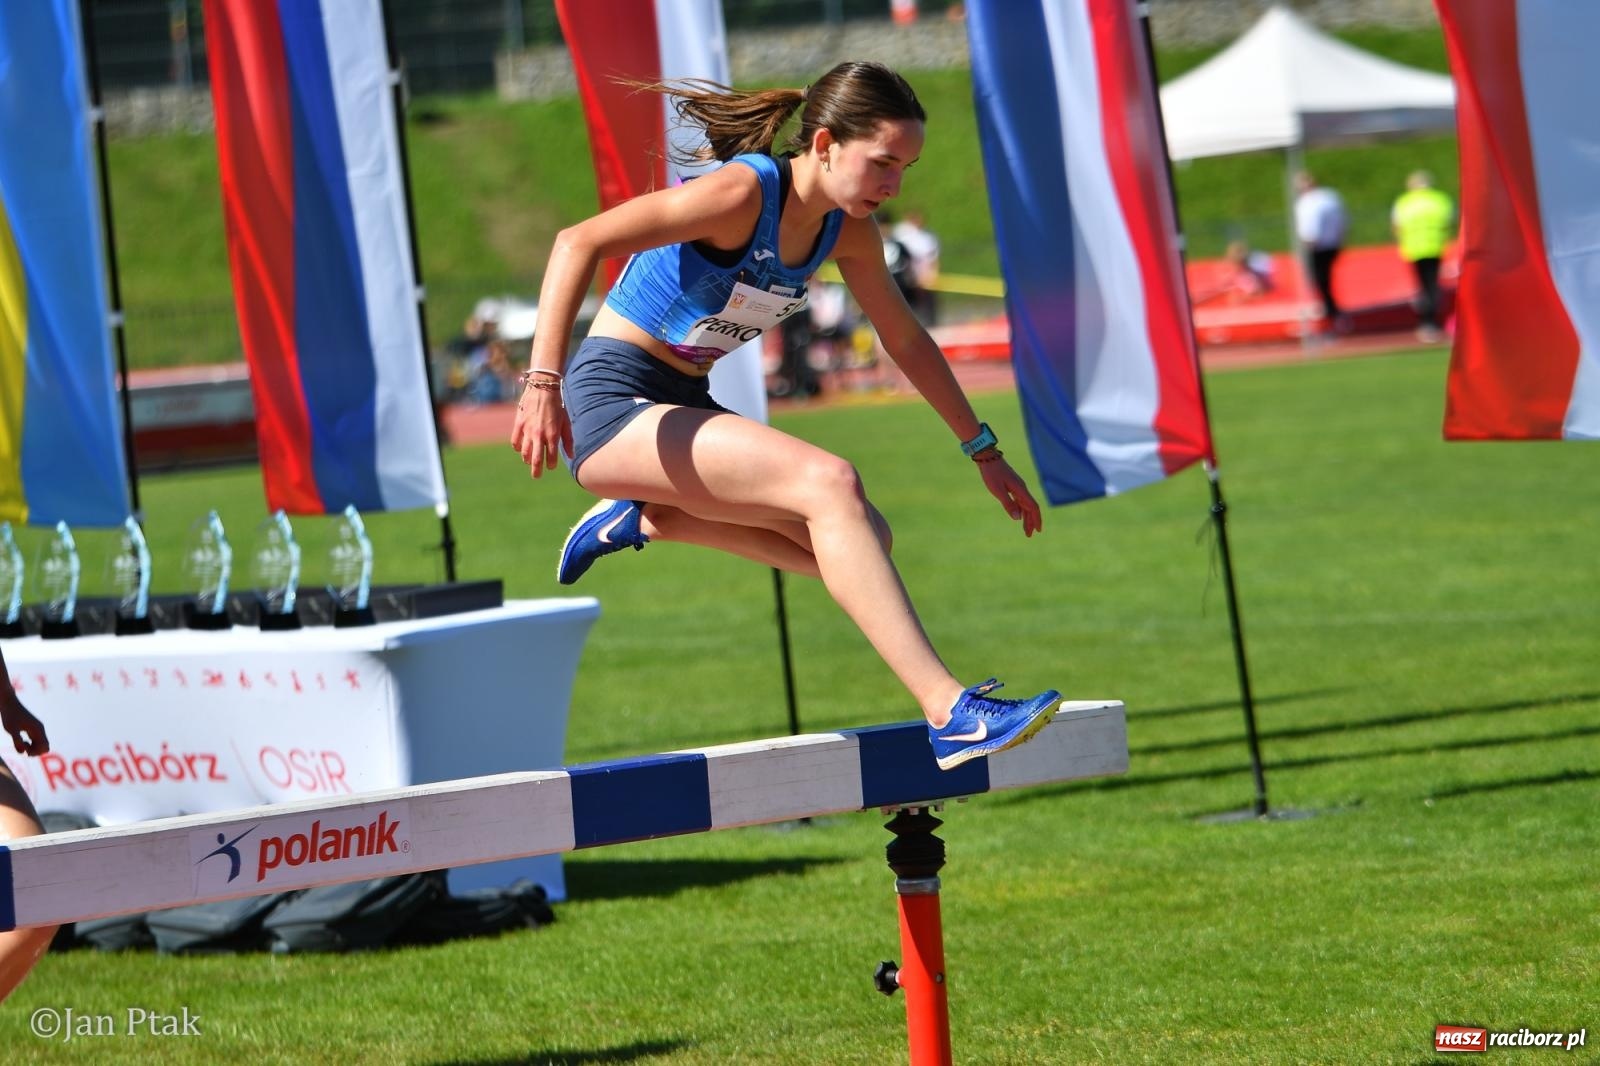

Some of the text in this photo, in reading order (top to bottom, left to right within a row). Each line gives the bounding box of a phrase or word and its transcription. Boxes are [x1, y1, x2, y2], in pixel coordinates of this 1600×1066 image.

[695, 317, 763, 342] PERKO
[40, 742, 353, 794] Racibórz OSiR
[257, 810, 401, 883] polanik
